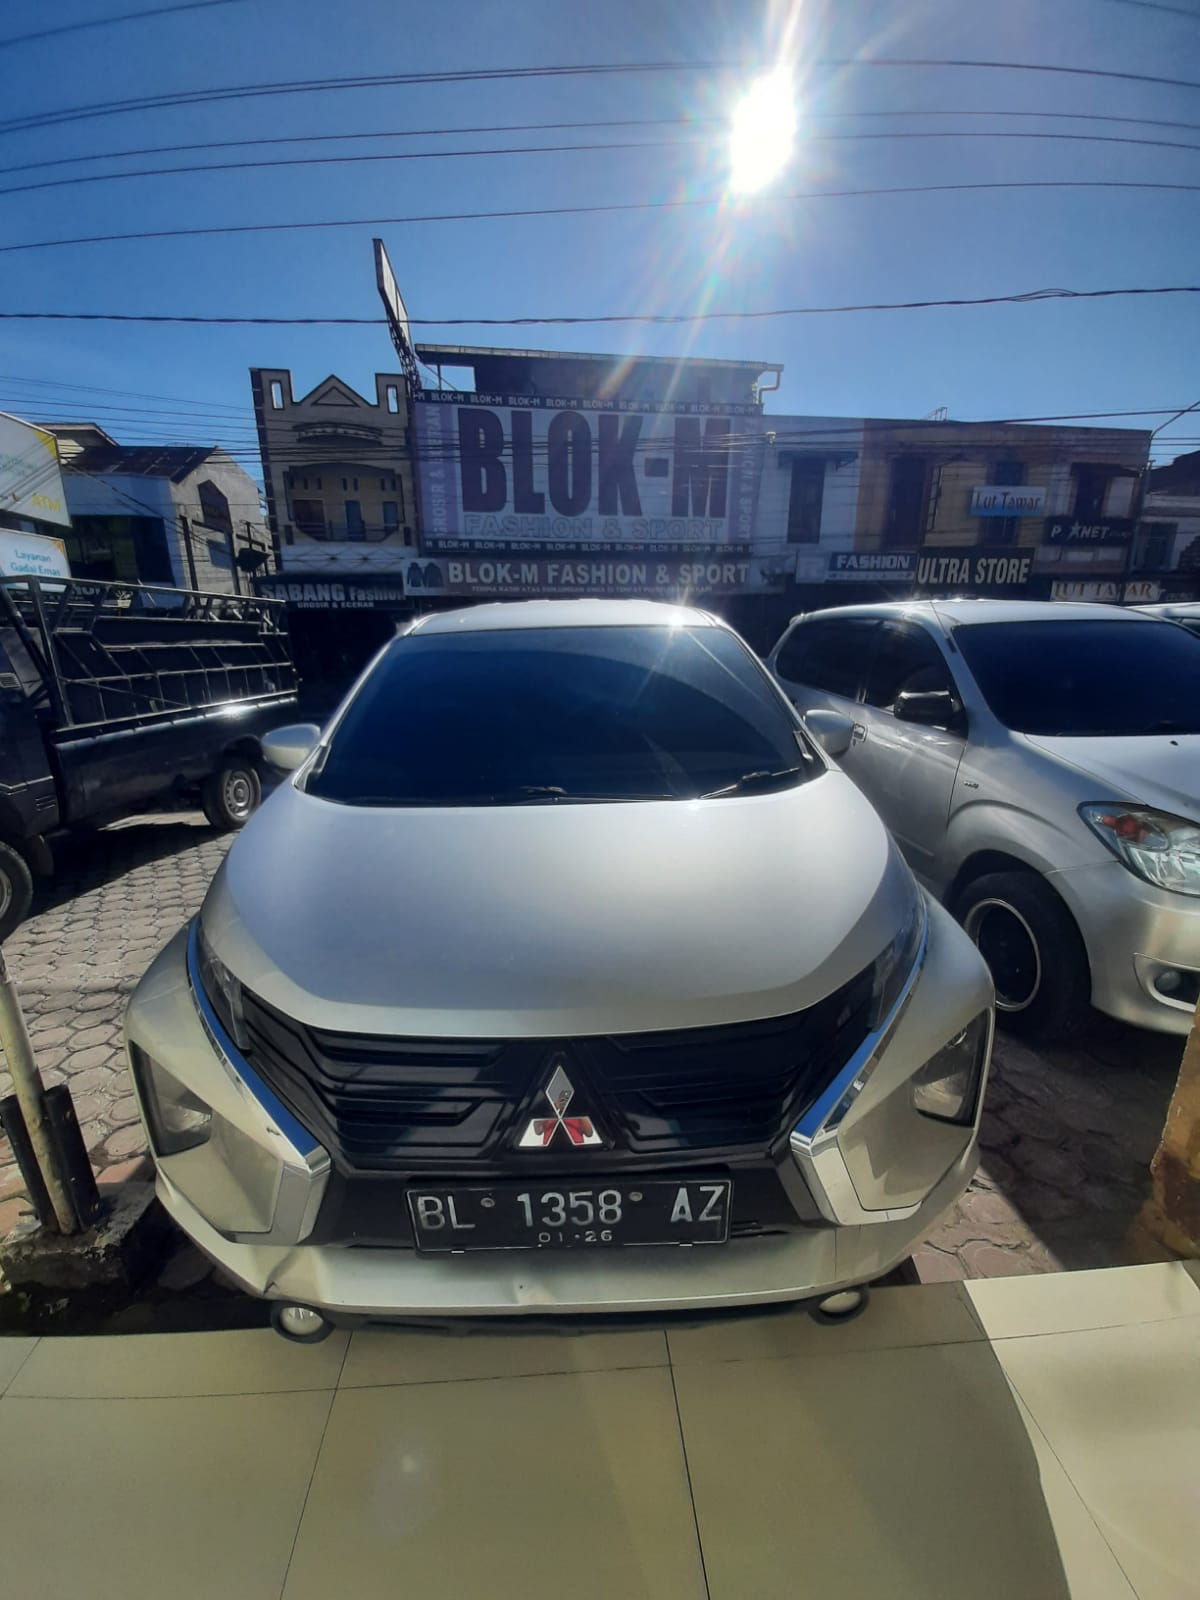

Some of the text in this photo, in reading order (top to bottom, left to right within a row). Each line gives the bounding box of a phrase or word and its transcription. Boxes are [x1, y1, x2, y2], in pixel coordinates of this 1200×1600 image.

[431, 392, 464, 402] BLOK-M
[470, 394, 503, 404] BLOK-M
[508, 396, 540, 405] BLOK-M
[546, 397, 577, 407] BLOK-M
[582, 399, 613, 409] BLOK-M
[458, 407, 732, 517] BLOK-M
[975, 491, 997, 509] Lut
[463, 514, 724, 540] FASHION & SPORT
[438, 540, 469, 549] BLOK-M
[474, 540, 505, 550] BLOK-M
[511, 541, 541, 550] BLOK-M
[546, 542, 576, 551] BLOK-M
[581, 543, 611, 552] BLOK-M
[615, 543, 645, 553] BLOK-M
[837, 555, 910, 569] FASHION
[917, 557, 1030, 585] ULTRA STORE
[448, 562, 750, 585] BLOK-M FASHION & SPORT
[260, 583, 345, 601] SABANG
[1055, 583, 1086, 599] LUT
[418, 1185, 725, 1230] BL 1358 AZ
